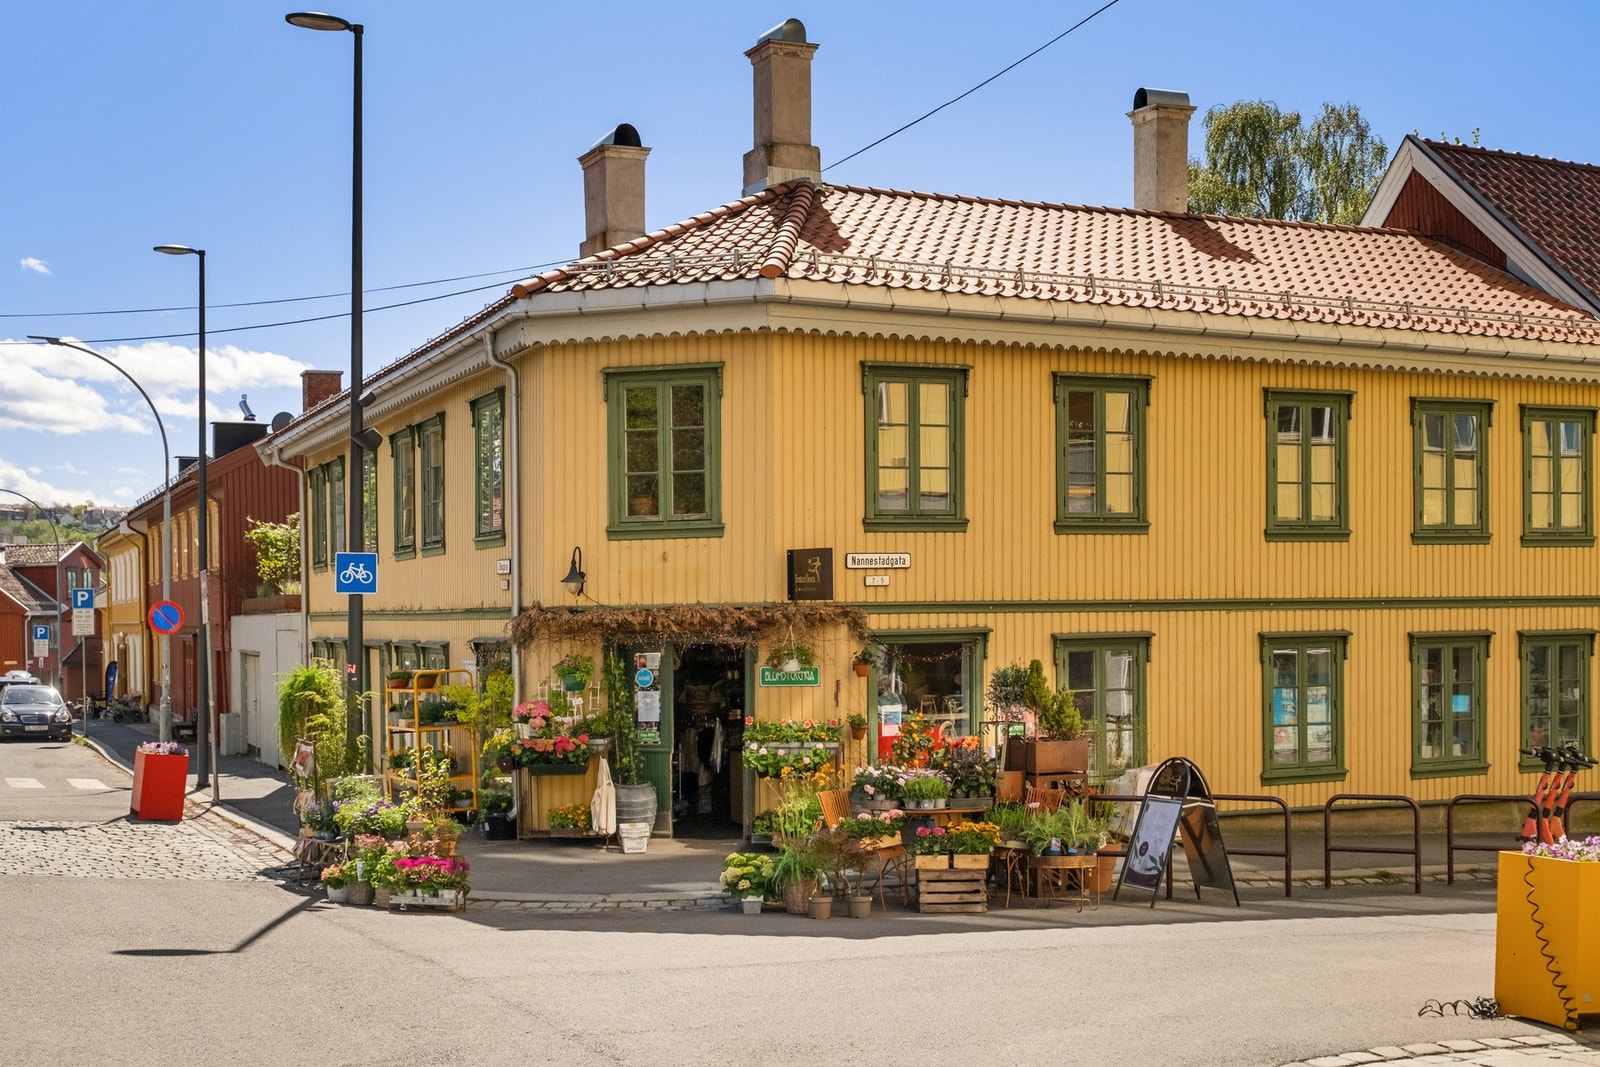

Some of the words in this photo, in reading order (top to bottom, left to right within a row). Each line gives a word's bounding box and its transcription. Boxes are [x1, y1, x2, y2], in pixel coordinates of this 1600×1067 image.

[851, 556, 906, 567] Nannestadgata
[77, 591, 89, 606] P
[37, 627, 46, 638] P
